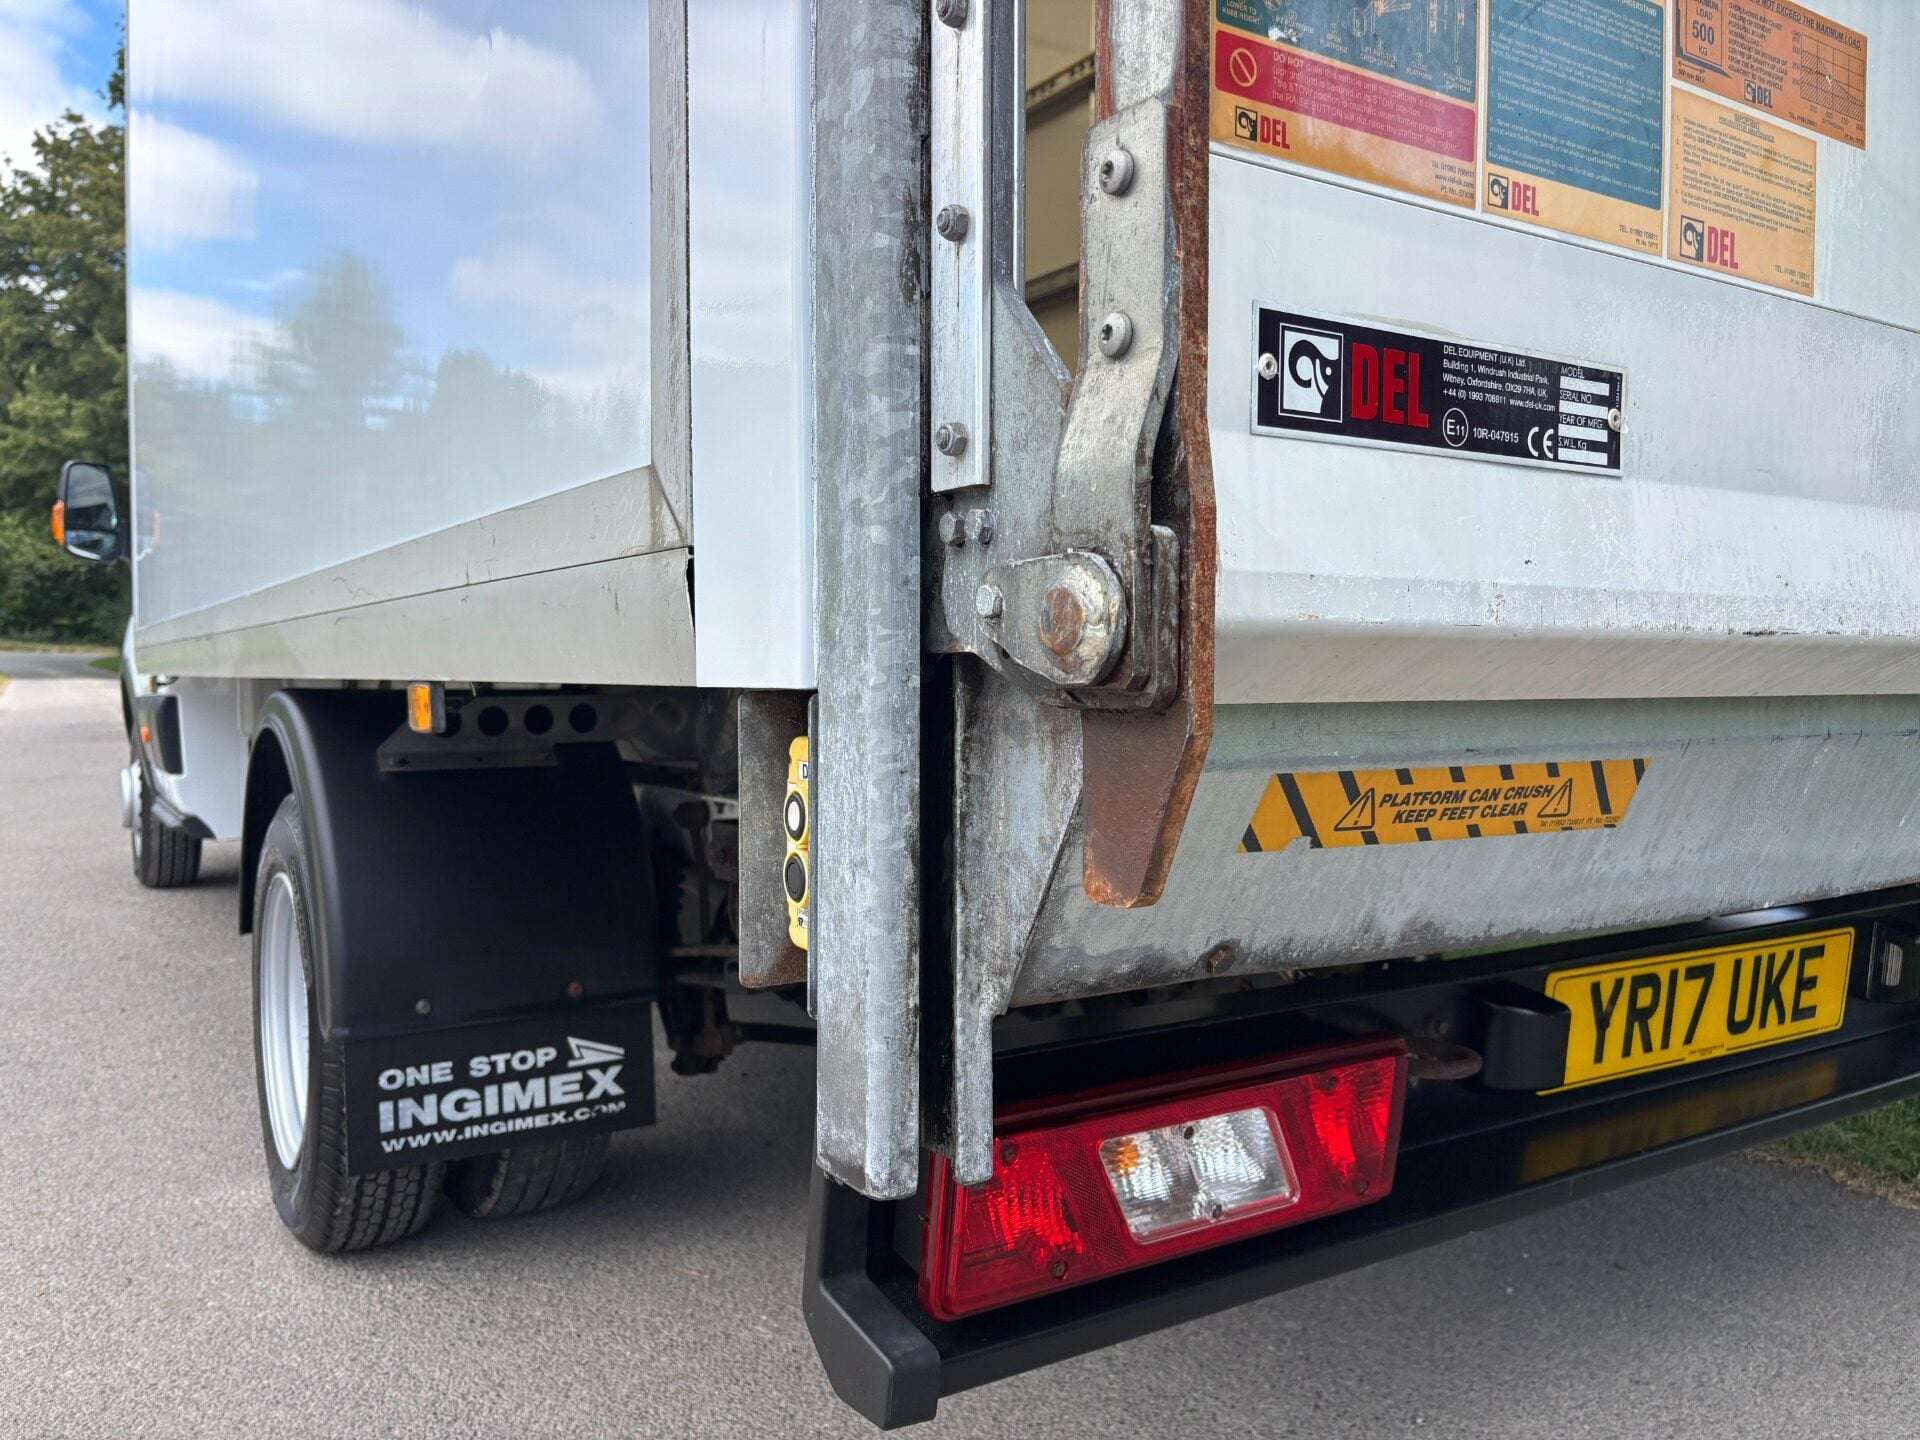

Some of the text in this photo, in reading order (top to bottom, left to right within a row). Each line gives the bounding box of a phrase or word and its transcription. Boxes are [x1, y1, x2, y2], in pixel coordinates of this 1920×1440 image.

[1696, 8, 1712, 20] LOAD
[1776, 2, 1801, 24] EXCEED
[1802, 14, 1815, 28] THE
[1816, 19, 1844, 42] MAXIMUM
[1692, 20, 1714, 46] 500
[1273, 51, 1284, 63] DO
[1757, 85, 1773, 108] DEL
[1260, 115, 1290, 150] DEL
[1512, 181, 1539, 216] DEL
[1707, 226, 1738, 269] DEL
[1444, 345, 1457, 356] DEL
[1458, 348, 1498, 362] EQUIPMENT
[1443, 359, 1468, 373] Building
[1477, 364, 1506, 377] Windrush
[1508, 369, 1534, 382] Industrial
[1560, 365, 1584, 379] MODEL
[1352, 342, 1428, 428] DEL
[1467, 376, 1504, 391] Oxfordshire,
[1505, 383, 1522, 393] OX29
[1443, 388, 1456, 397] +44
[1458, 390, 1466, 400] (0)
[1468, 391, 1483, 401] 1993
[1510, 400, 1556, 412] www.del-uk.com
[1560, 390, 1592, 404] SERIAL NO
[1560, 414, 1603, 429] YEAR OF MFG
[1473, 427, 1519, 443] 10R-047915
[1578, 440, 1587, 451] Kg
[1379, 785, 1555, 807] PLATFORM CAN CRUSH
[1392, 803, 1528, 824] KEEP FEET CLEAR
[1590, 945, 1826, 1064] YR17 UKE
[378, 1047, 558, 1090] ONE STOP
[379, 1064, 625, 1134] INGIMEX
